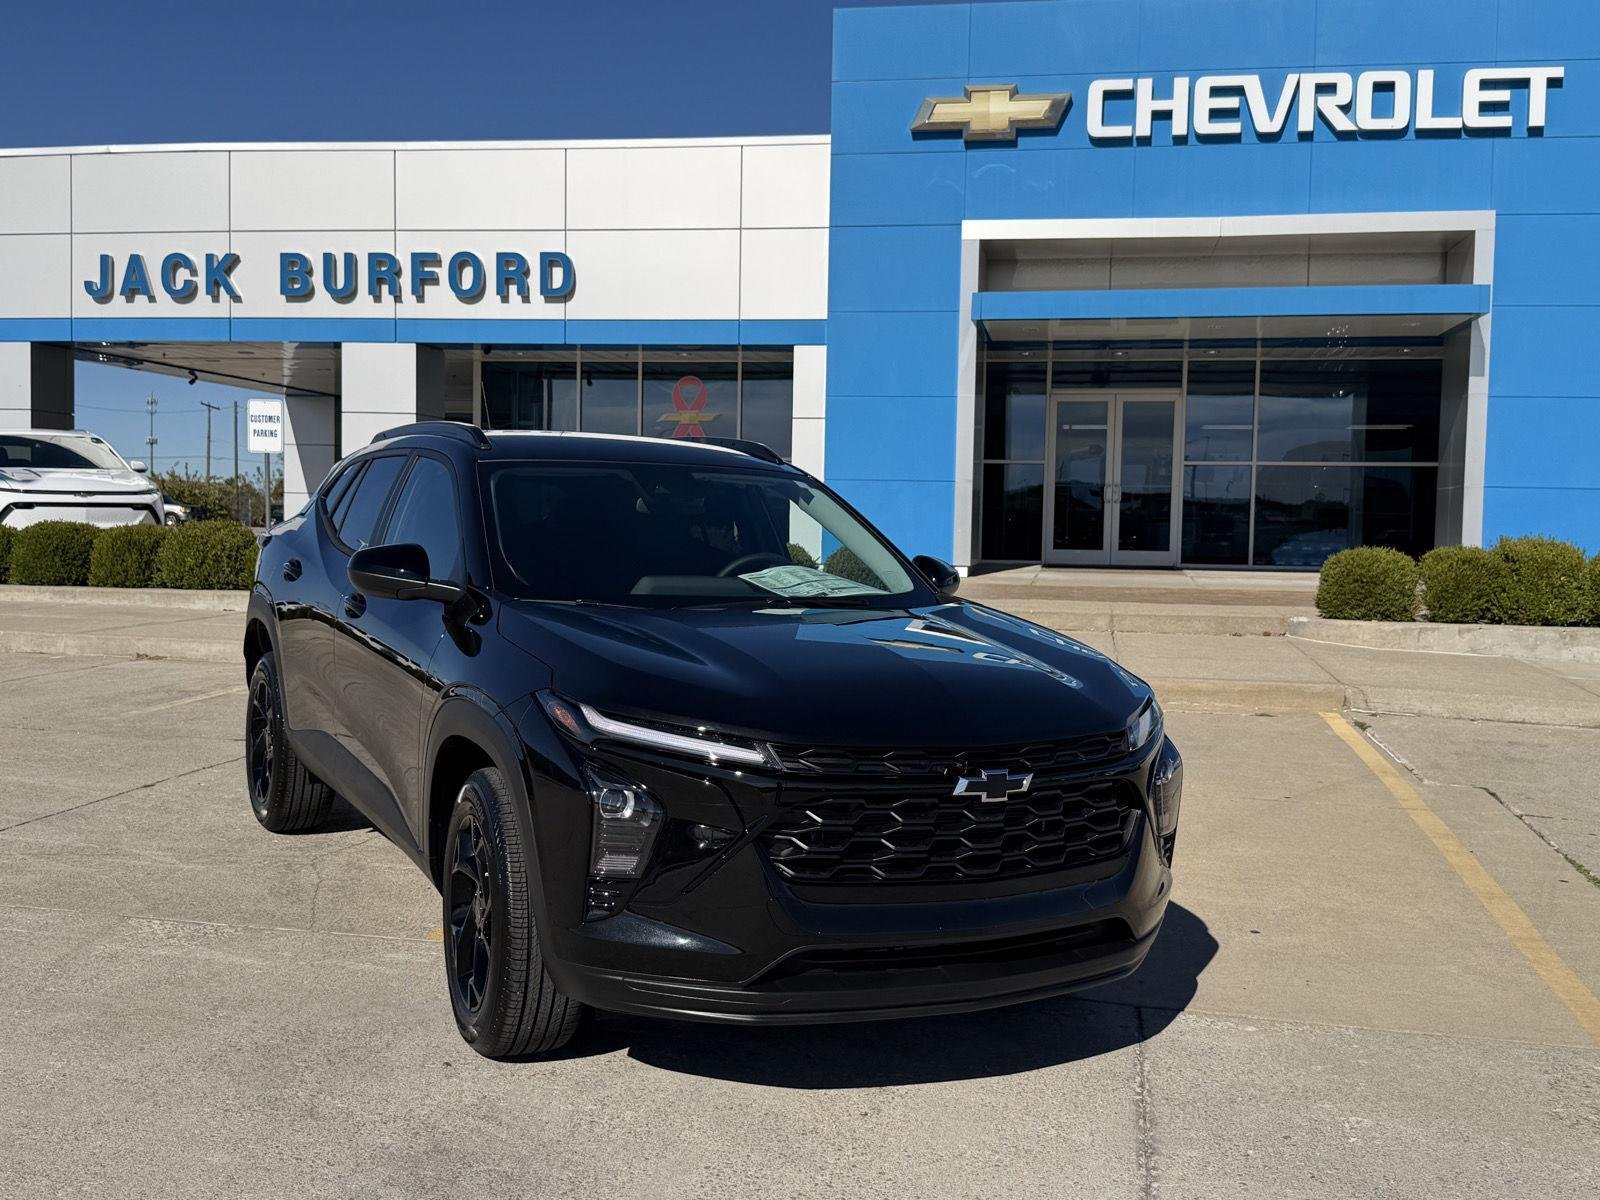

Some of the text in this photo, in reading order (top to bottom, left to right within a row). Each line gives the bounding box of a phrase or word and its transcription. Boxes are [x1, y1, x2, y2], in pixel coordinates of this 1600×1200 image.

[1086, 66, 1565, 140] CHEVROLET
[84, 251, 576, 301] JACK BURFORD
[250, 414, 281, 424] CUSTOMER
[252, 428, 278, 438] PARKING
